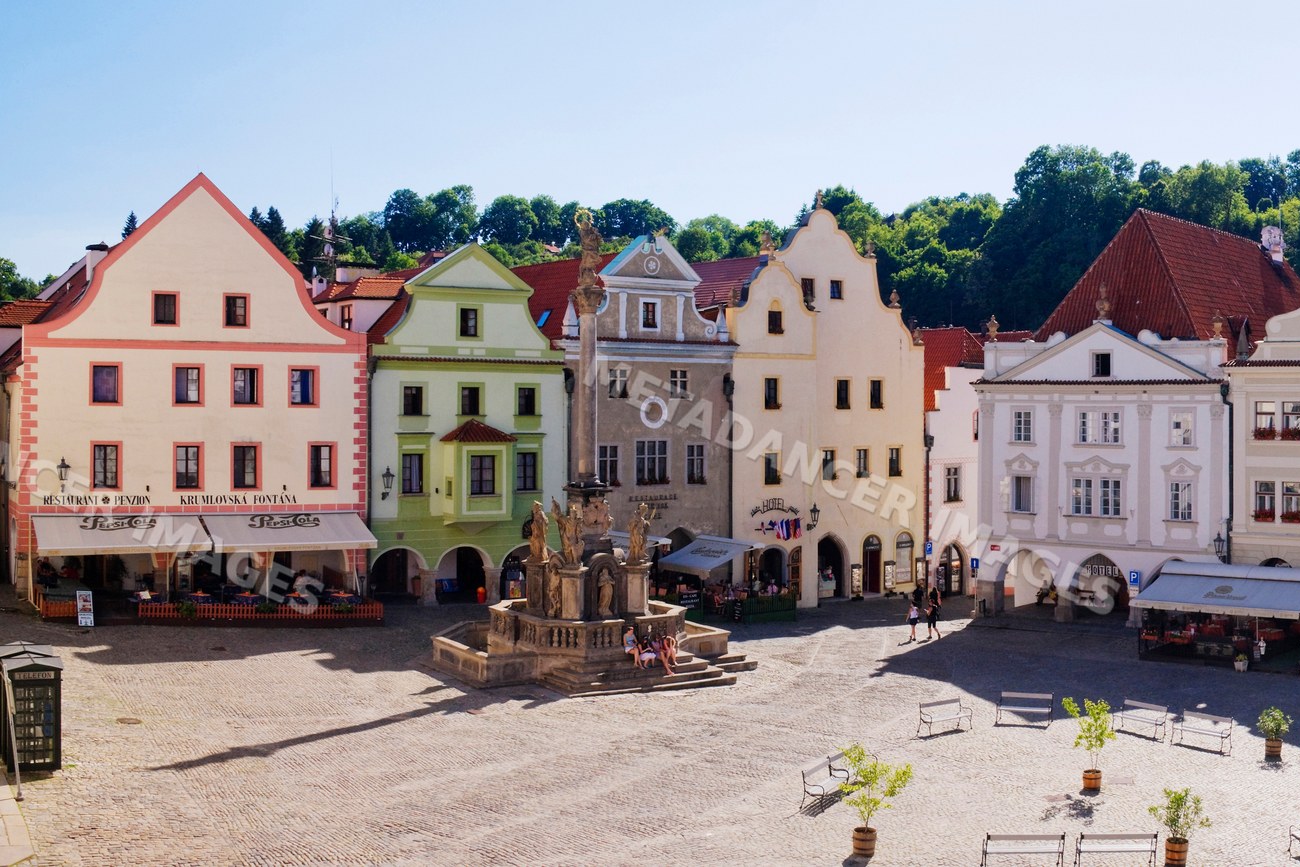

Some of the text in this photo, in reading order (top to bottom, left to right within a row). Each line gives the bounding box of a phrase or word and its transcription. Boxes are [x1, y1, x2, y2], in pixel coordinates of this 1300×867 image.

[43, 495, 151, 506] RESTAURANT PENZION
[180, 492, 297, 505] KRUMLOVSKÁ FONTÁNA
[762, 498, 785, 511] HOTEL
[1086, 564, 1119, 577] HOTEL
[1130, 572, 1137, 581] P
[18, 672, 52, 680] TELEFON
